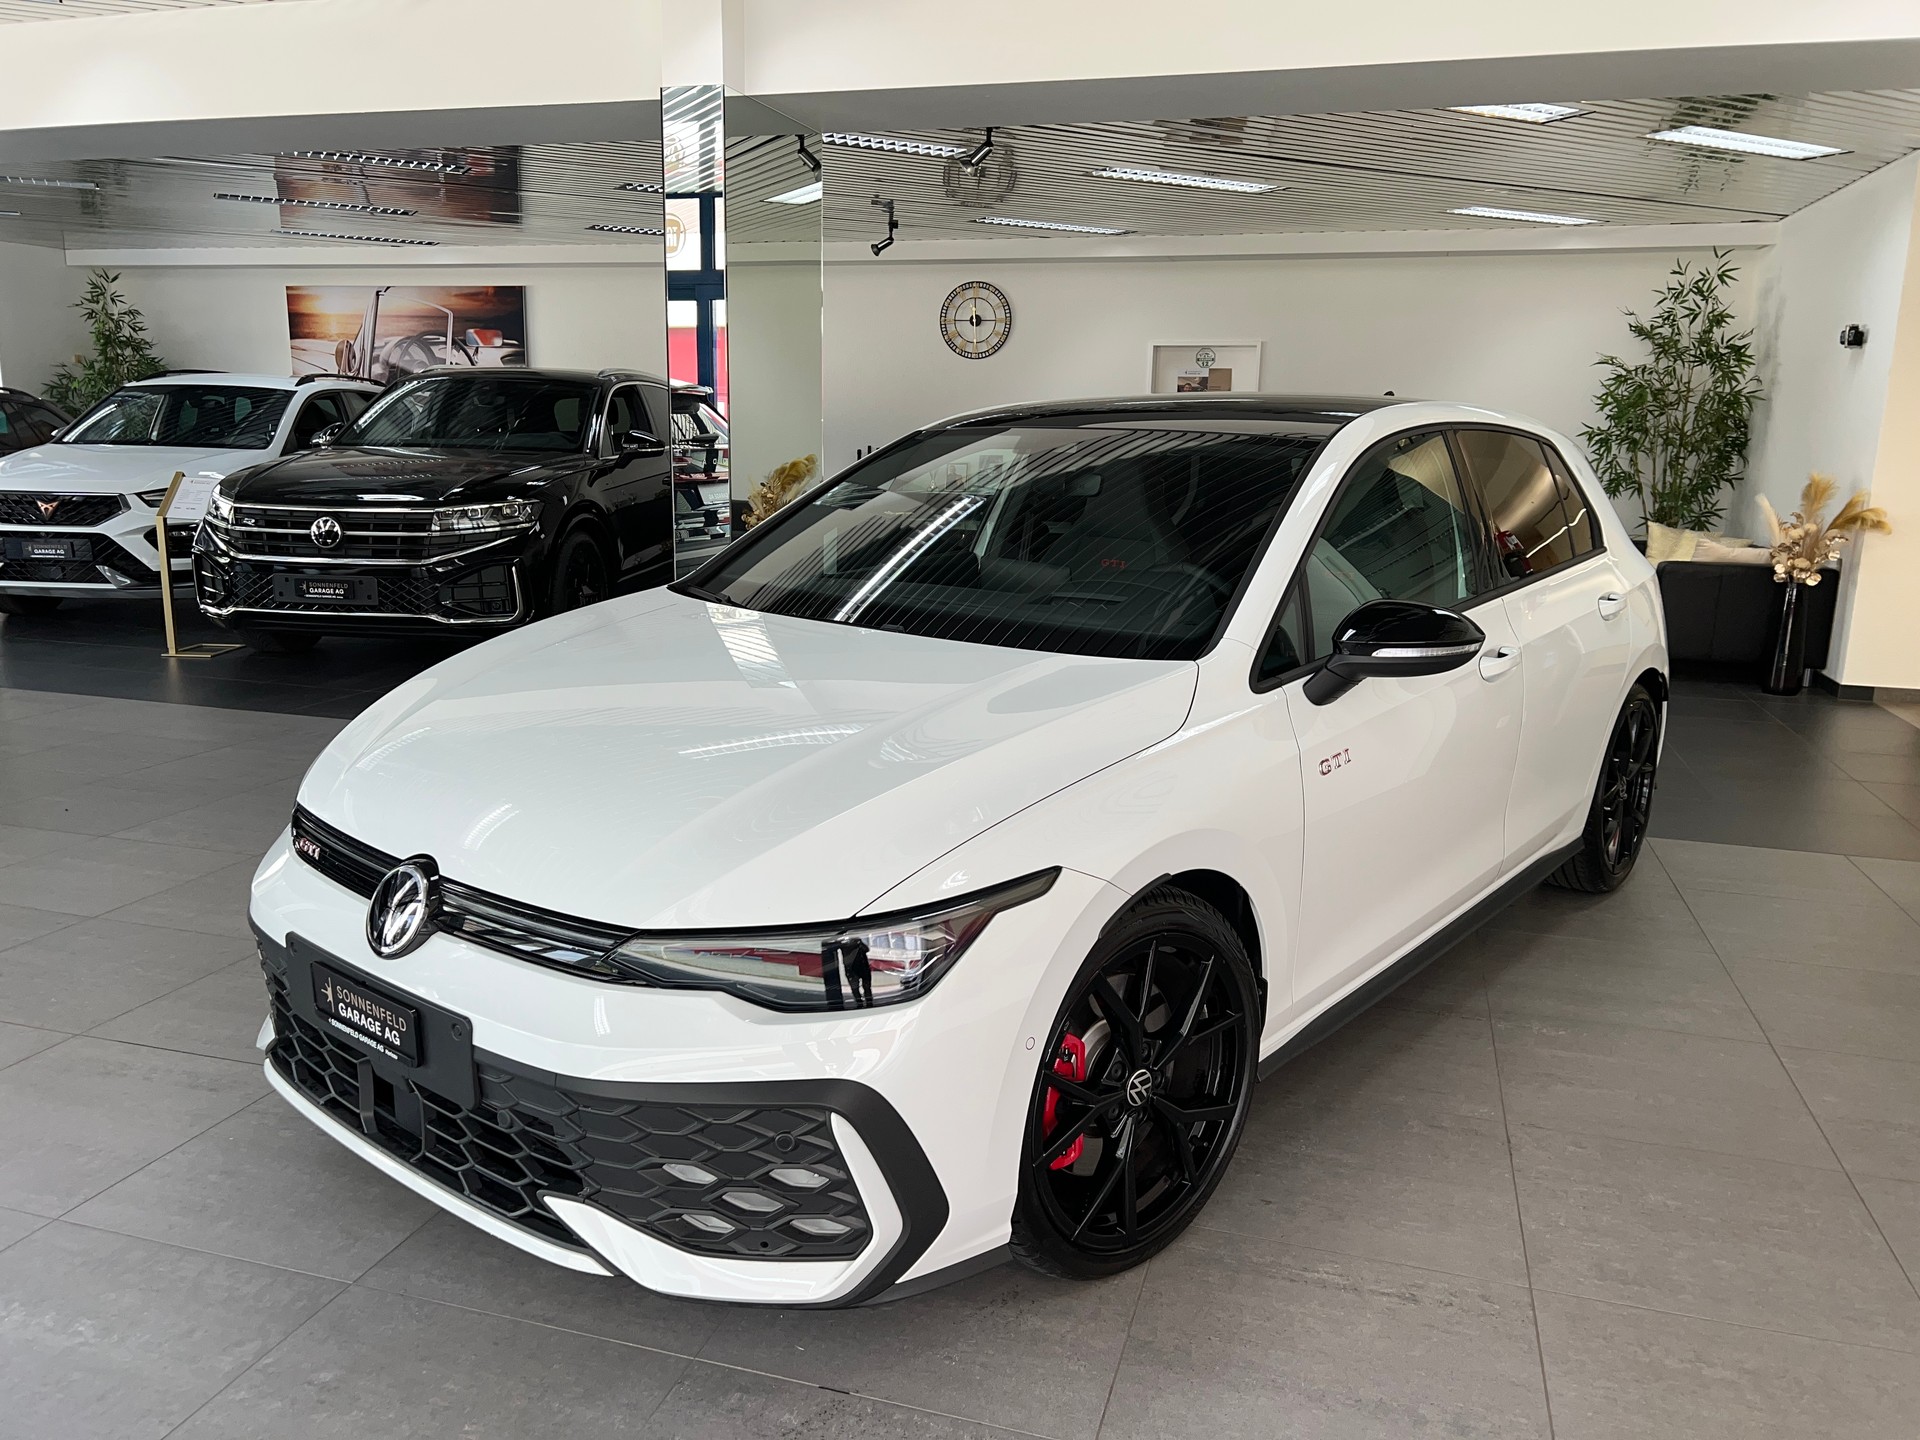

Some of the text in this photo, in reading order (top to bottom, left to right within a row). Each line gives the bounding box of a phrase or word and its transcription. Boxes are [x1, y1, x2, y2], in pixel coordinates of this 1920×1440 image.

[1101, 559, 1126, 569] GTI
[1318, 748, 1352, 776] GTI
[336, 985, 406, 1032] SONNENFELD
[338, 1002, 401, 1046] GARAGE AG
[331, 1018, 384, 1053] SONNENFELD GARAGE AG
